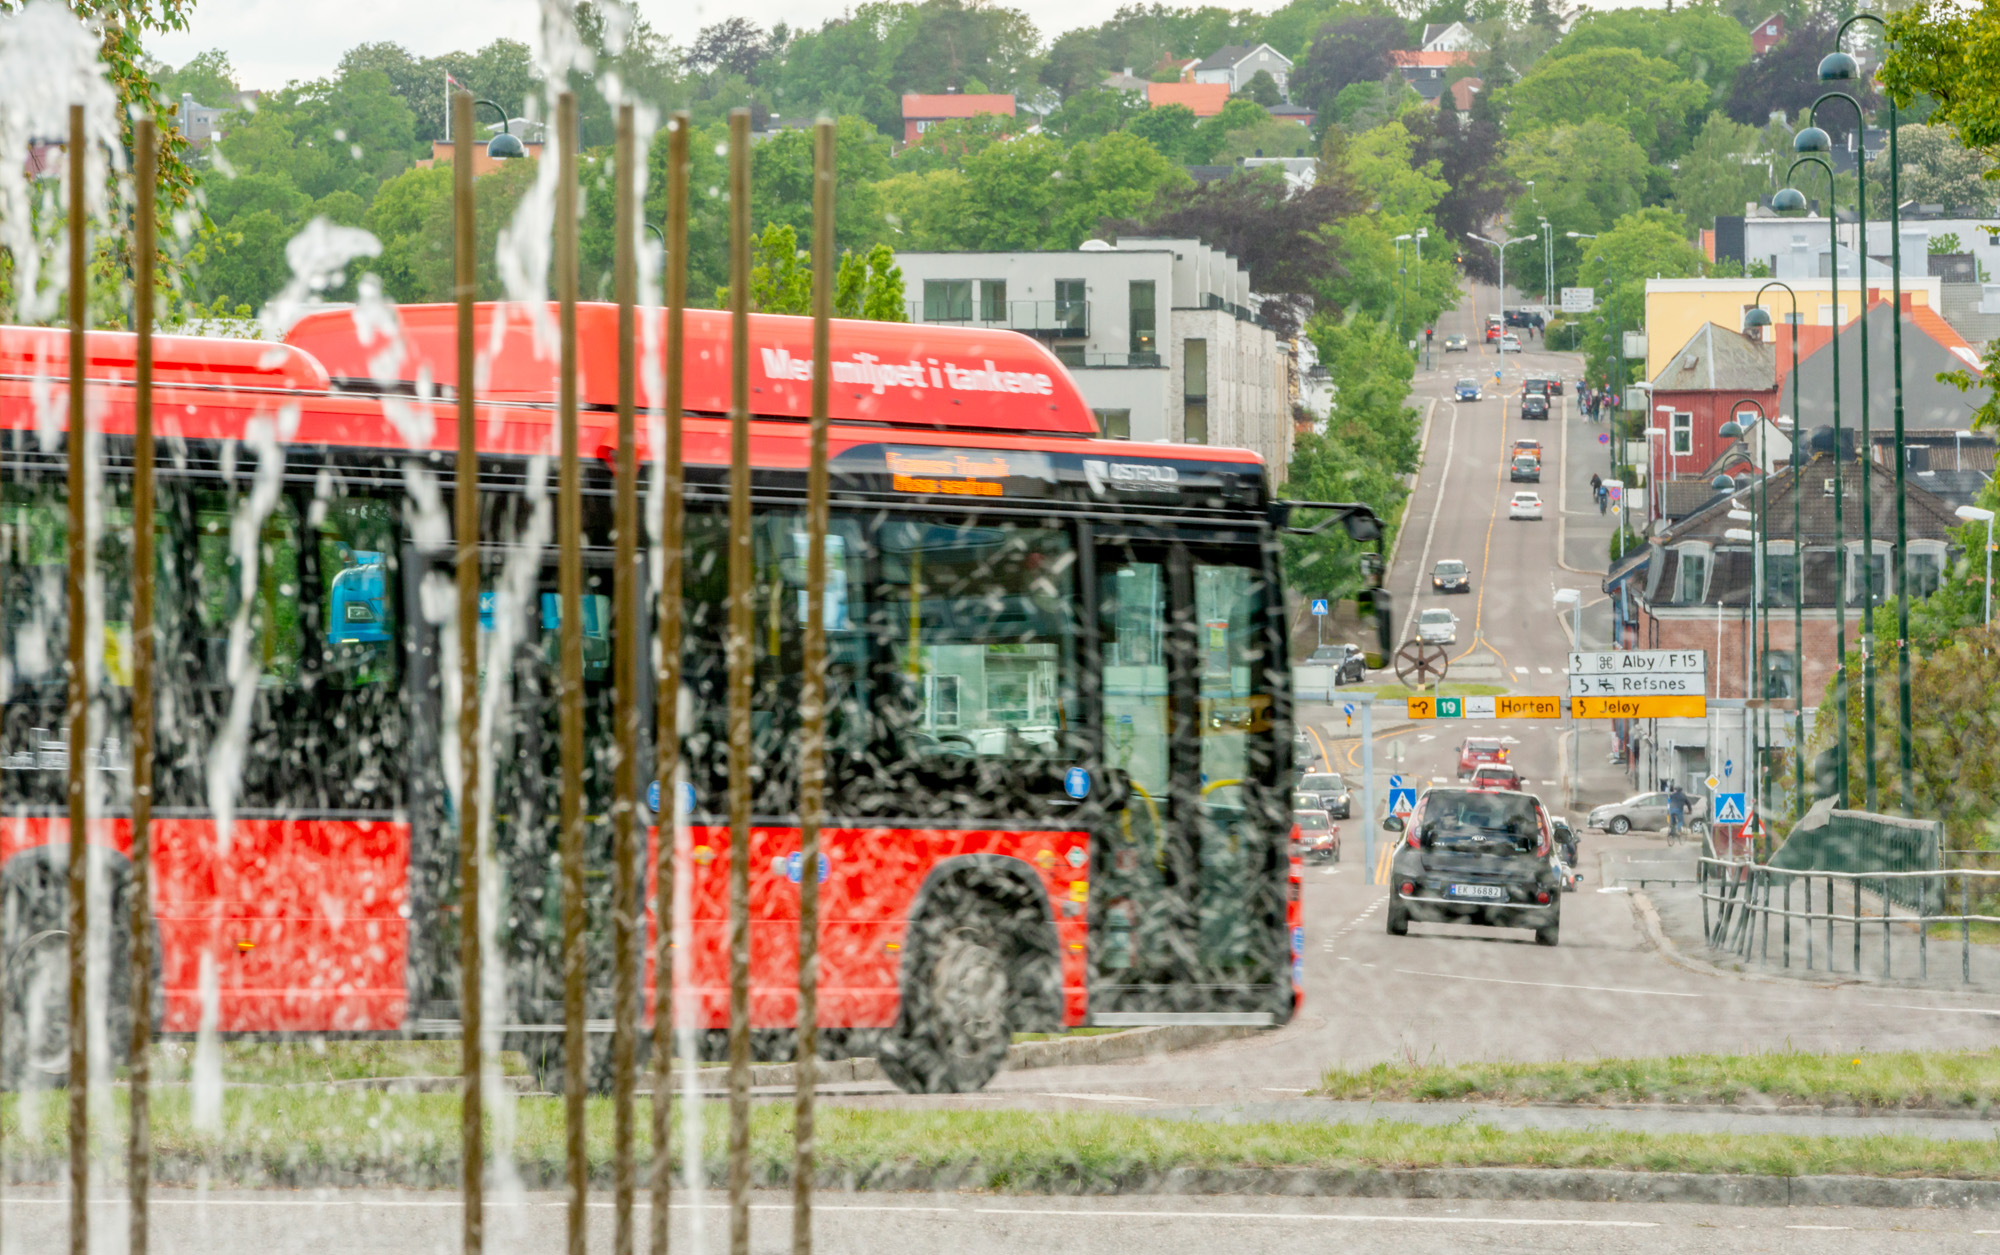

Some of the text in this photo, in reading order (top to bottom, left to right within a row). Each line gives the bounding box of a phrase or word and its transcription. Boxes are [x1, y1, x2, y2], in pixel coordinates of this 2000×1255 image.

[927, 357, 944, 389] i
[943, 359, 1054, 396] tankene
[1622, 654, 1655, 671] Alby
[1622, 677, 1686, 690] Refsnes
[1441, 701, 1456, 714] 19
[1501, 700, 1554, 713] Horten
[1600, 700, 1640, 716] Jeløy
